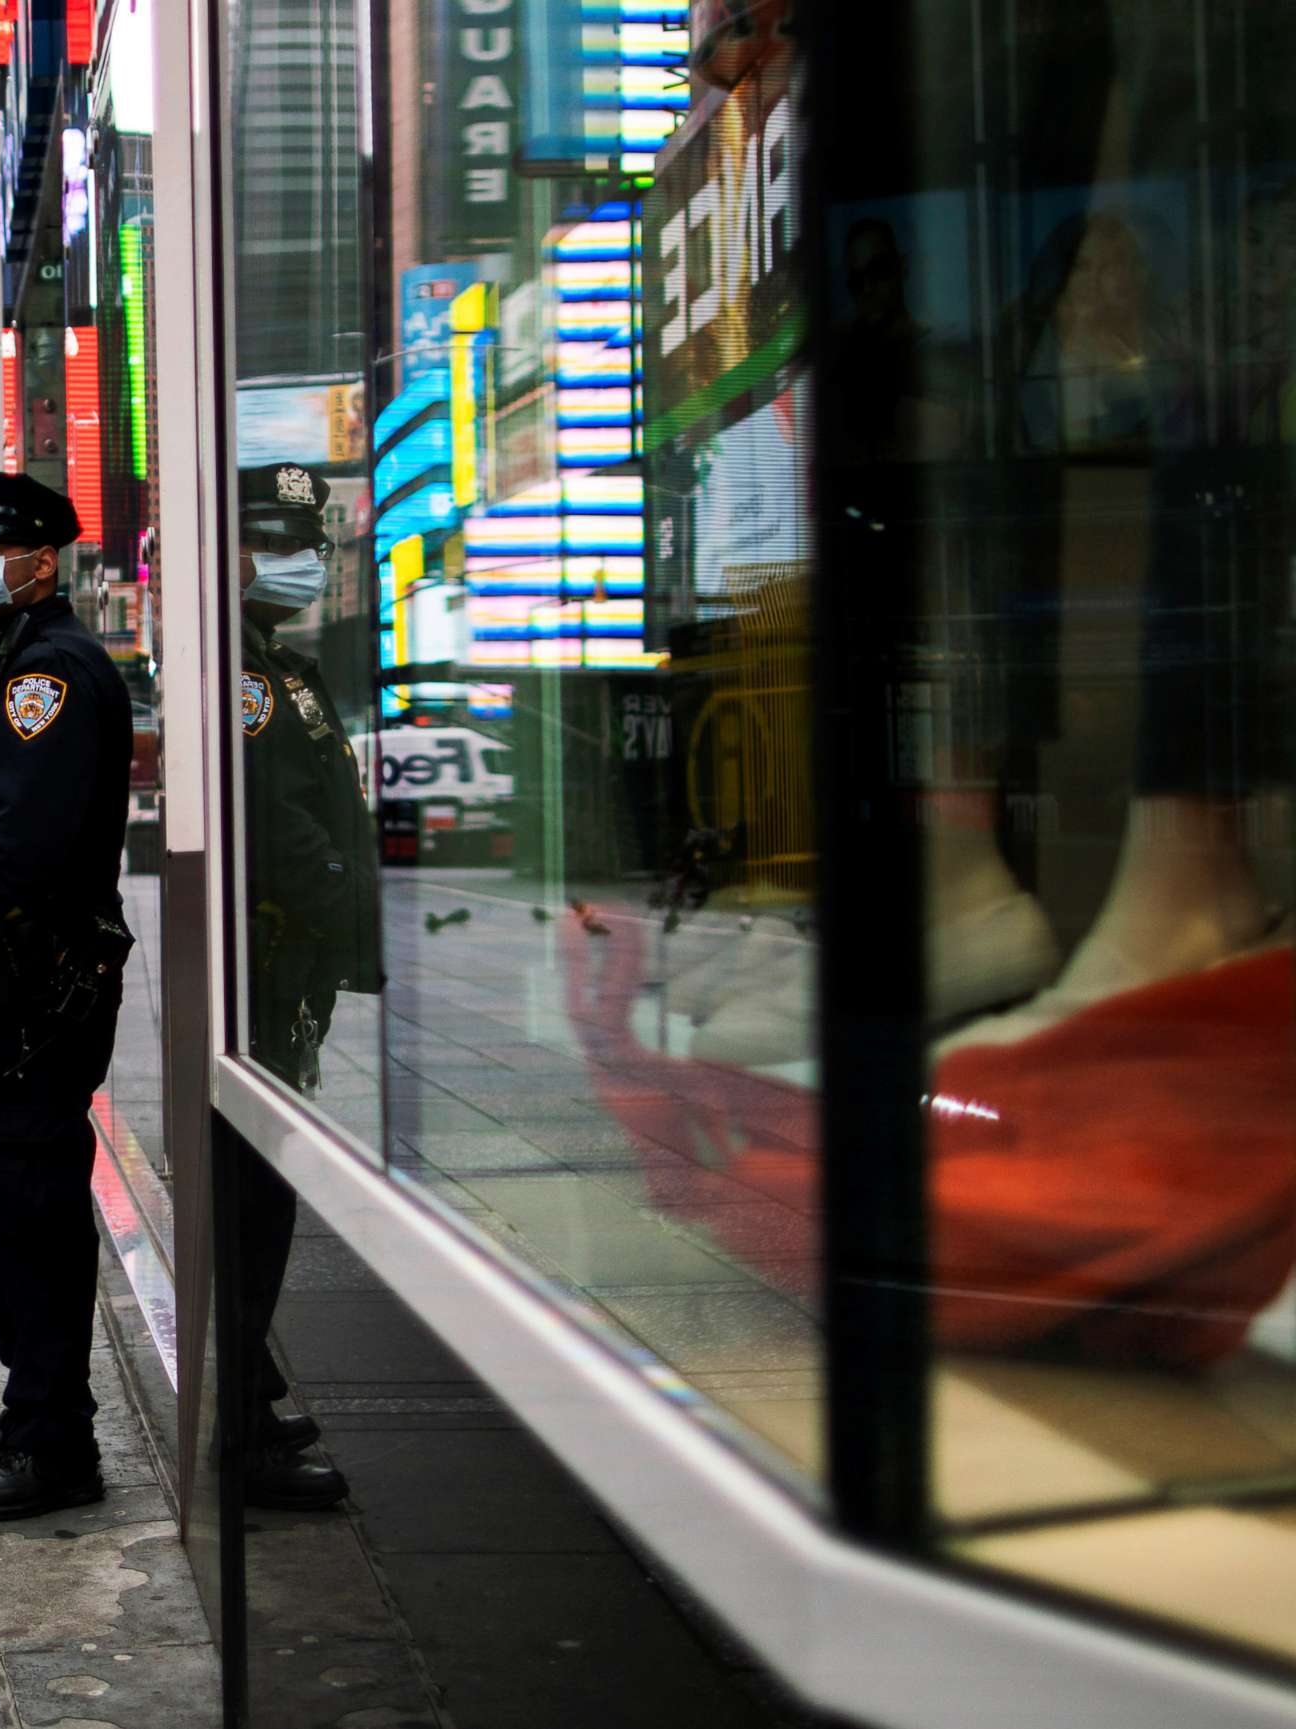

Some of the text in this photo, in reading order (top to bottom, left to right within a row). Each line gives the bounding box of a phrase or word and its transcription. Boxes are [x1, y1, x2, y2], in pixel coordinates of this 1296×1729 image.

[11, 684, 61, 699] DEPARTMENT
[22, 678, 52, 687] POLICE
[8, 700, 23, 728] CITY OF
[31, 702, 60, 733] NEW YORK
